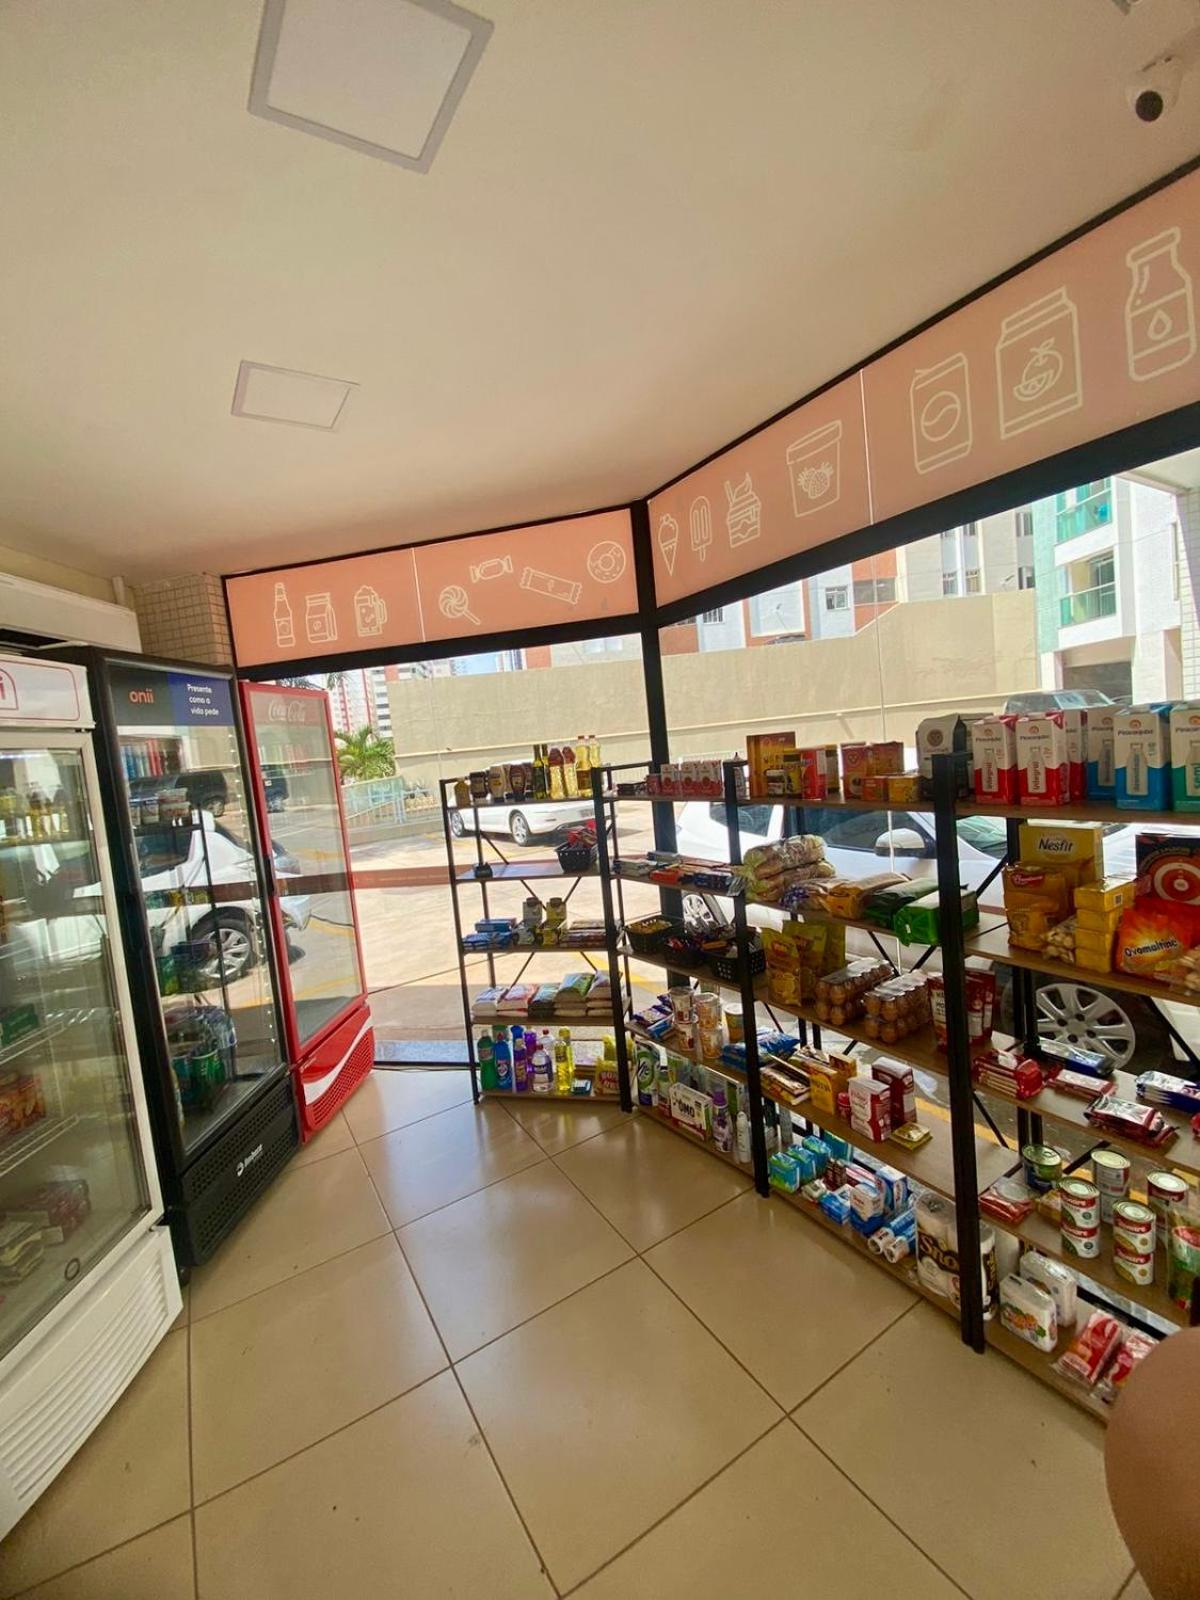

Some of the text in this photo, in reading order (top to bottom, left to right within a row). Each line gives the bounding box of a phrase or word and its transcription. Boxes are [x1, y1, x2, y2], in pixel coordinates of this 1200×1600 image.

[187, 684, 212, 694] Presente
[129, 689, 154, 704] onii
[189, 695, 205, 704] como
[191, 707, 219, 717] vida pede
[1038, 838, 1074, 853] Nesfit
